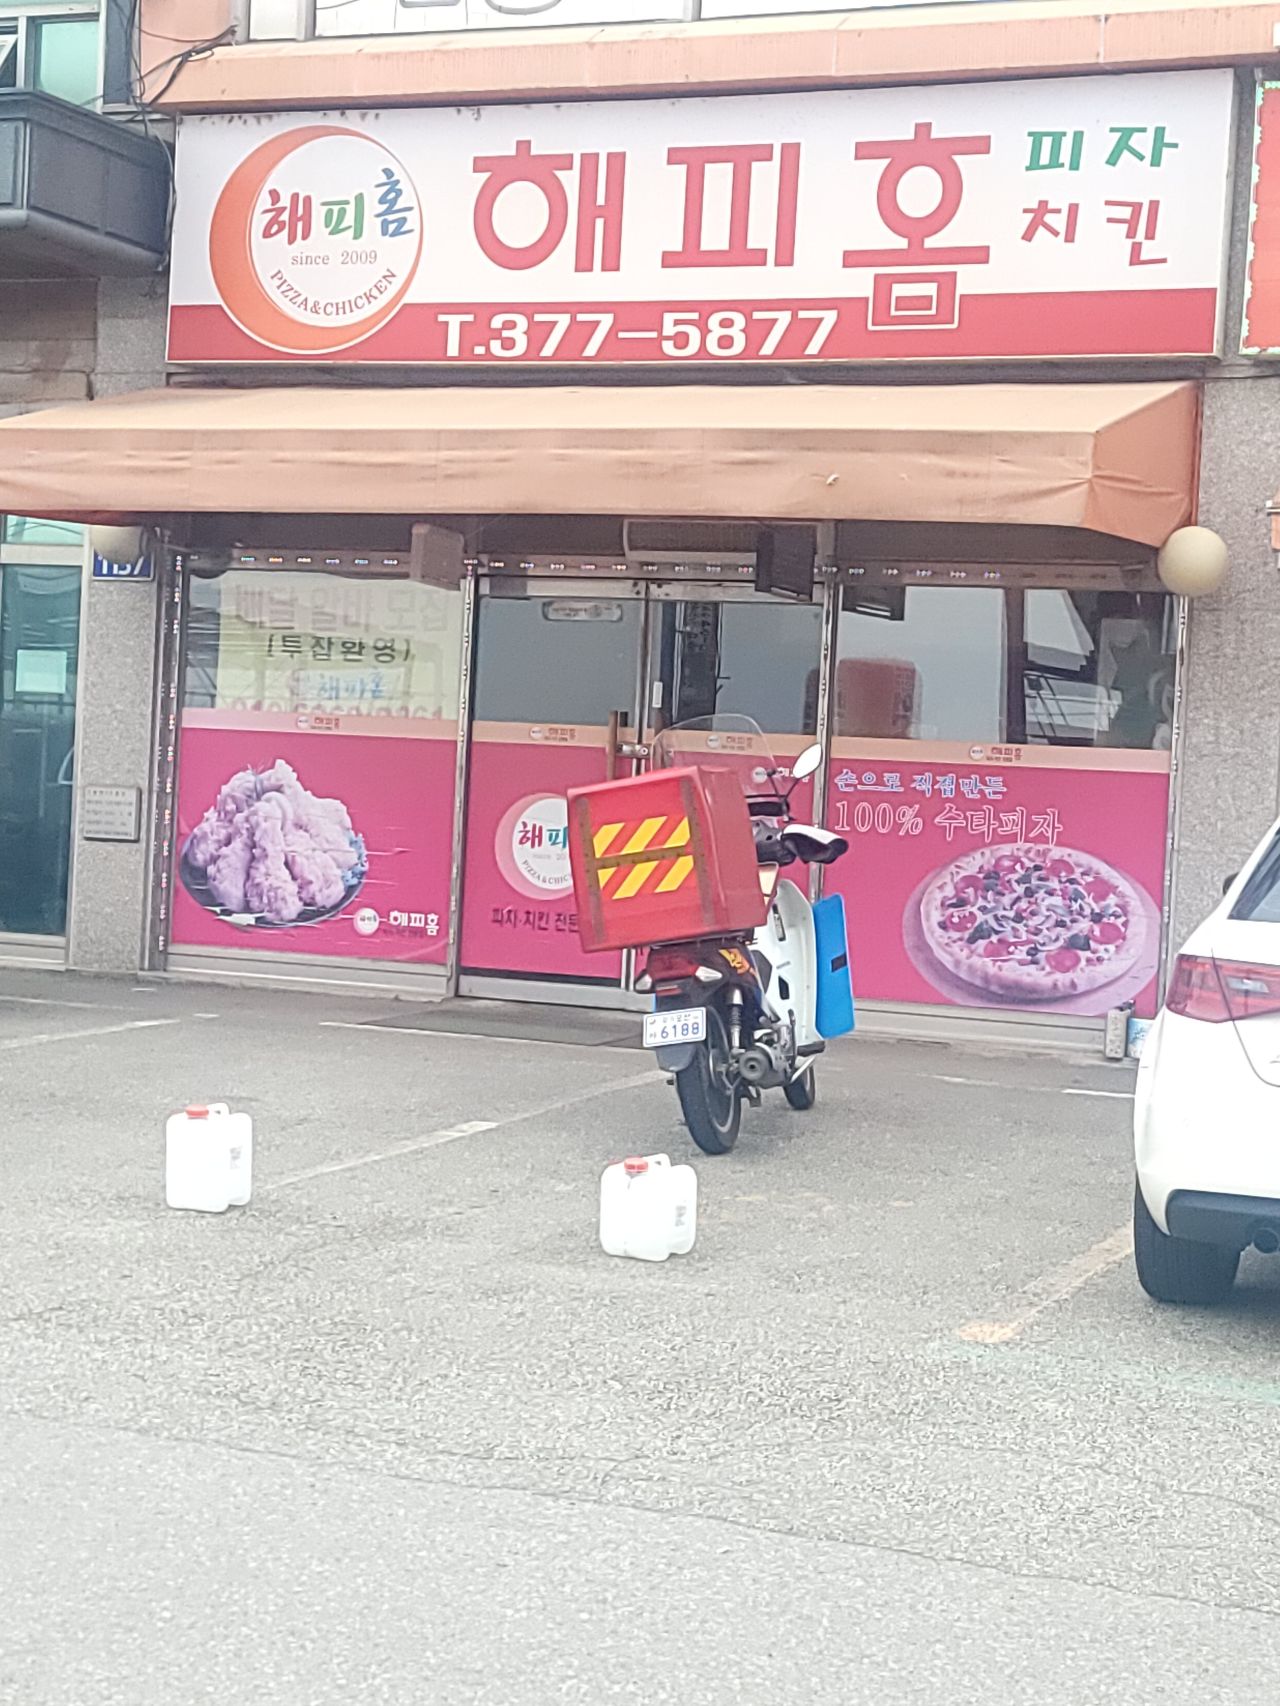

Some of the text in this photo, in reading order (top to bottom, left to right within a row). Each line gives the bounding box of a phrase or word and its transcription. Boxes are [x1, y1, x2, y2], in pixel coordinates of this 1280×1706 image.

[1025, 126, 1179, 172] 피자
[260, 167, 415, 245] 해피홈
[472, 121, 992, 327] 해피홈
[1020, 199, 1168, 266] 치킨
[291, 250, 378, 266] since 2009
[270, 267, 397, 317] PIZZA&CHICKEN
[834, 768, 904, 792] 손으로
[518, 820, 569, 849] 해피
[834, 800, 923, 836] 100%
[389, 910, 440, 936] 해피홈
[660, 1022, 700, 1040] 6188
